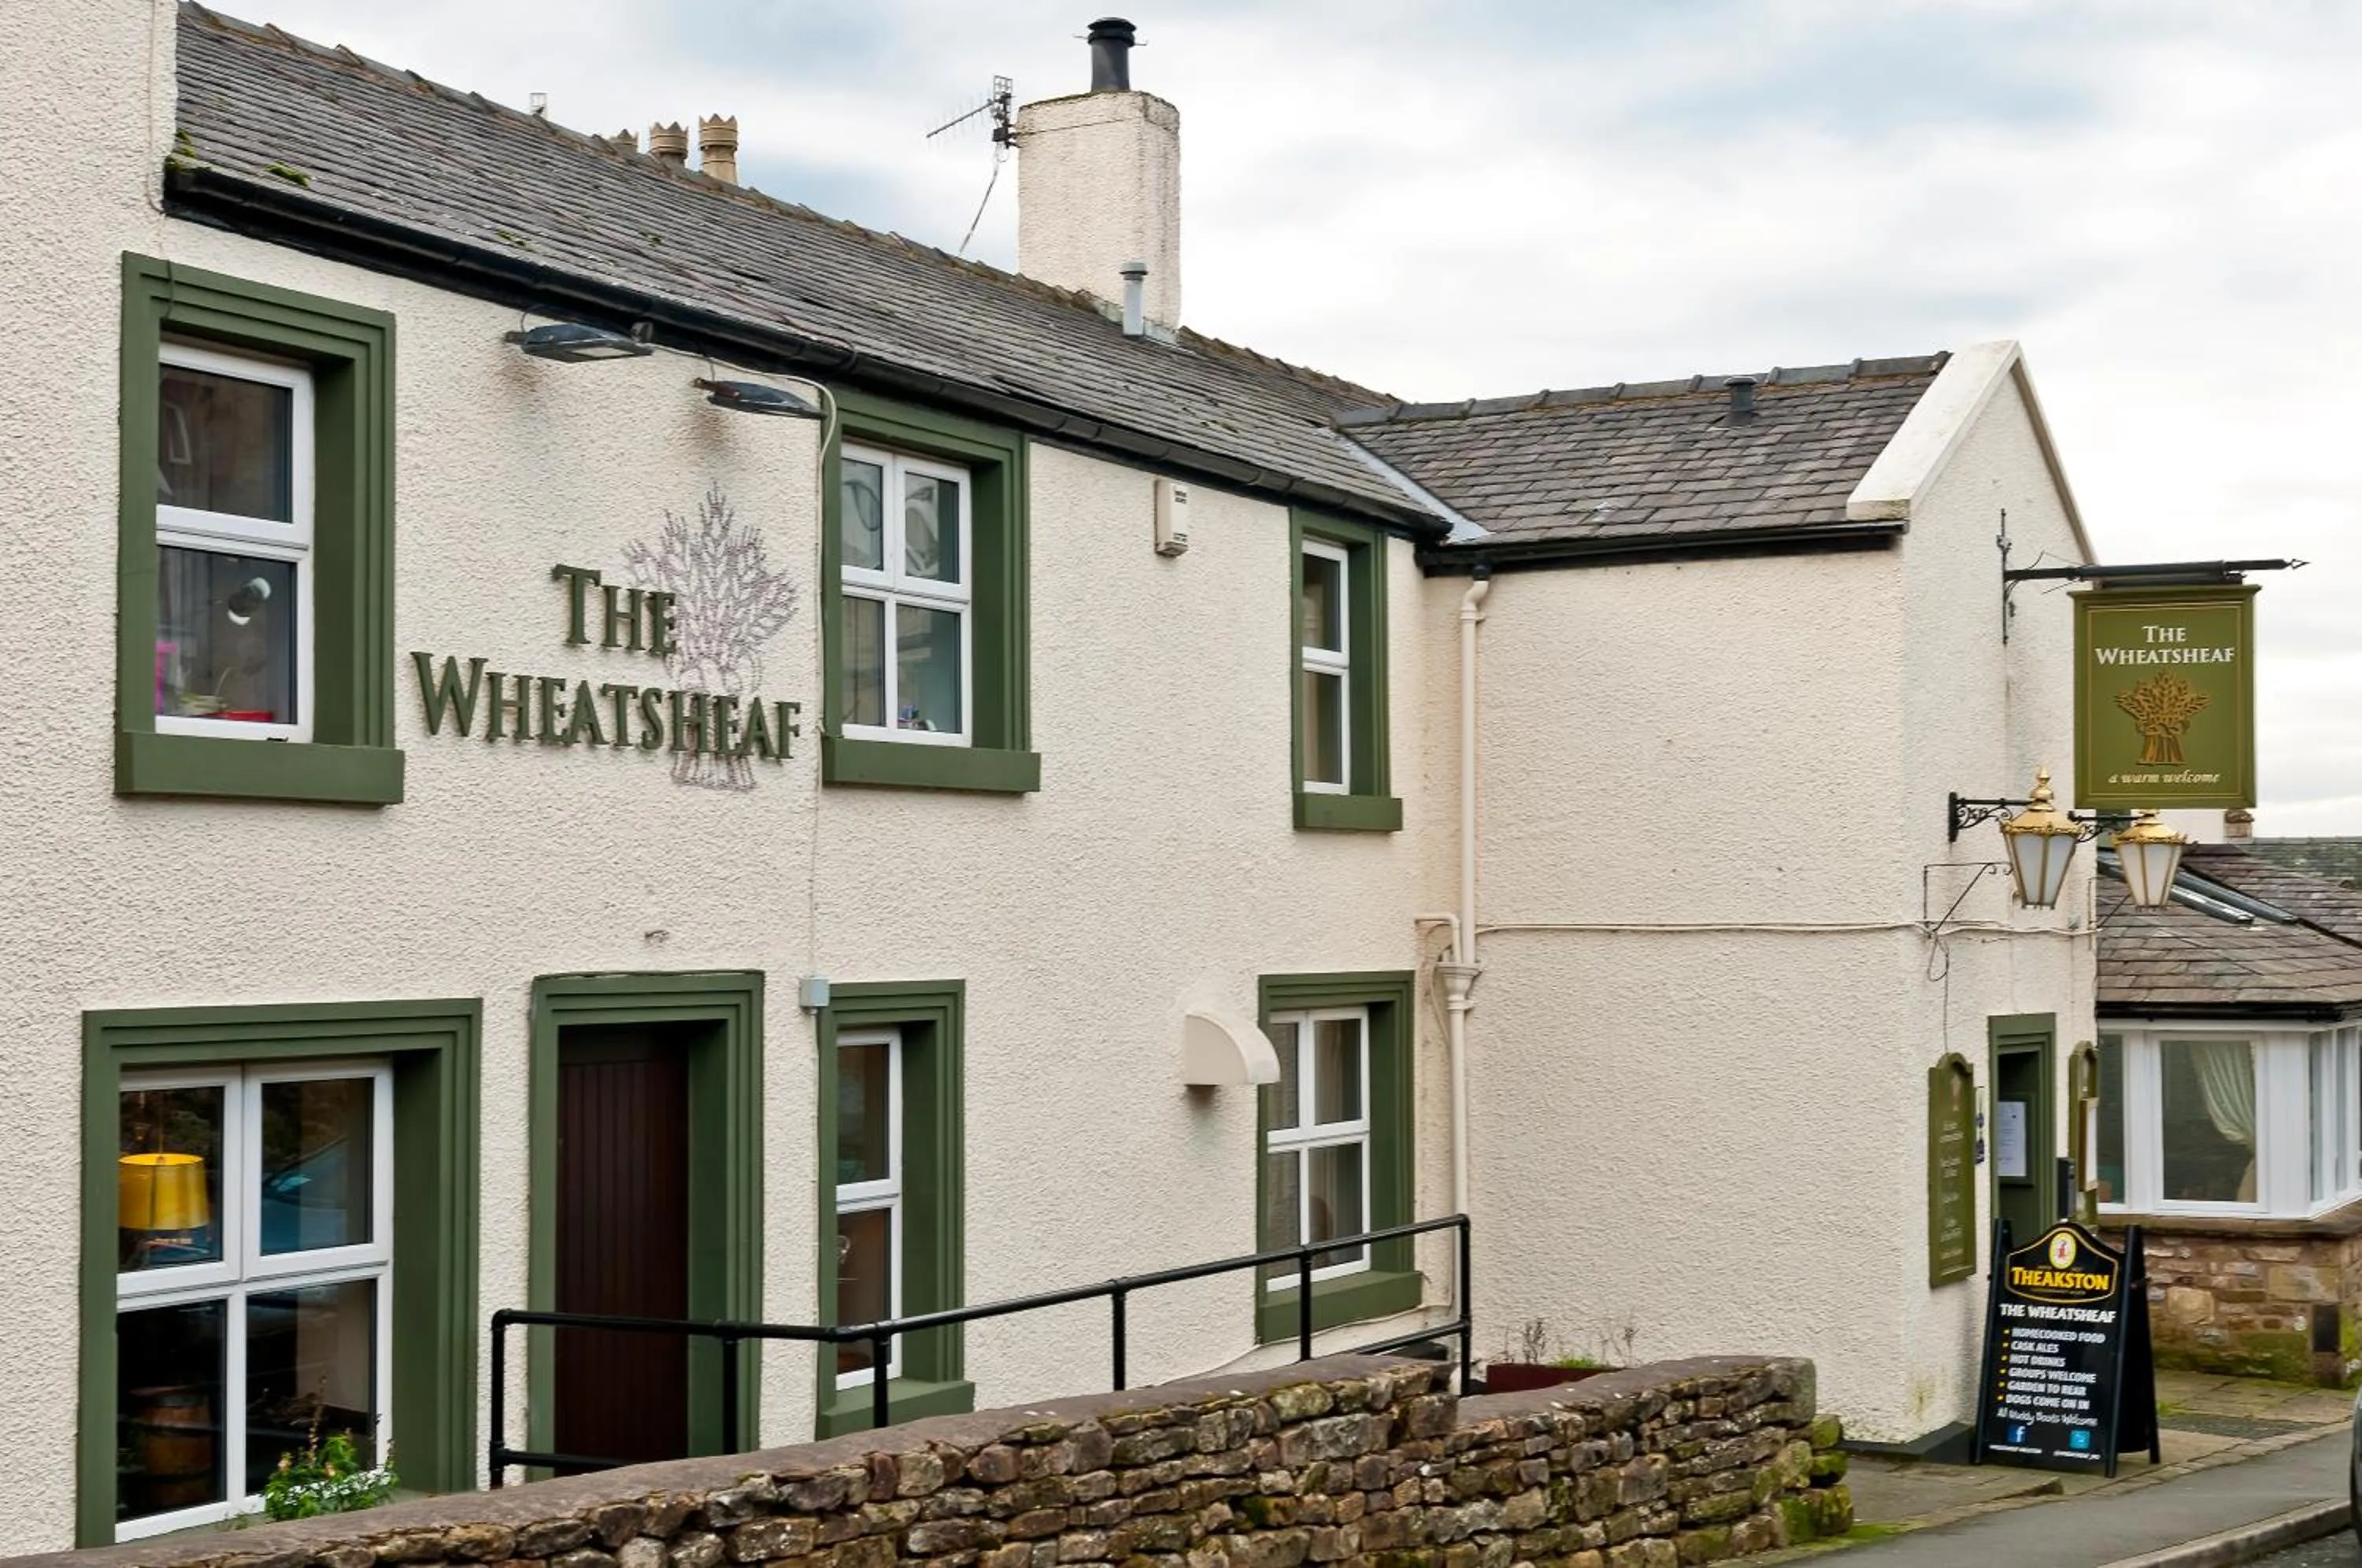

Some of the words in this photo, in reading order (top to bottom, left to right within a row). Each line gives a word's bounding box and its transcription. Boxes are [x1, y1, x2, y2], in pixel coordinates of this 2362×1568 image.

[552, 564, 676, 655] THE
[2142, 626, 2186, 643] THE
[2094, 647, 2235, 664] WHEATSHEAF
[410, 651, 801, 762] WHEATSHEAF
[2108, 774, 2119, 783] a
[2121, 774, 2160, 783] warm
[2163, 769, 2220, 783] welcome
[2011, 1267, 2109, 1290] THEAKSTON
[1999, 1304, 2026, 1317] THE
[2027, 1305, 2116, 1323] WHEATSHEAF
[2078, 1332, 2106, 1344] FOOD
[2010, 1341, 2035, 1352] CASK
[2035, 1342, 2060, 1353] ALES
[2047, 1370, 2097, 1383] WELCOME
